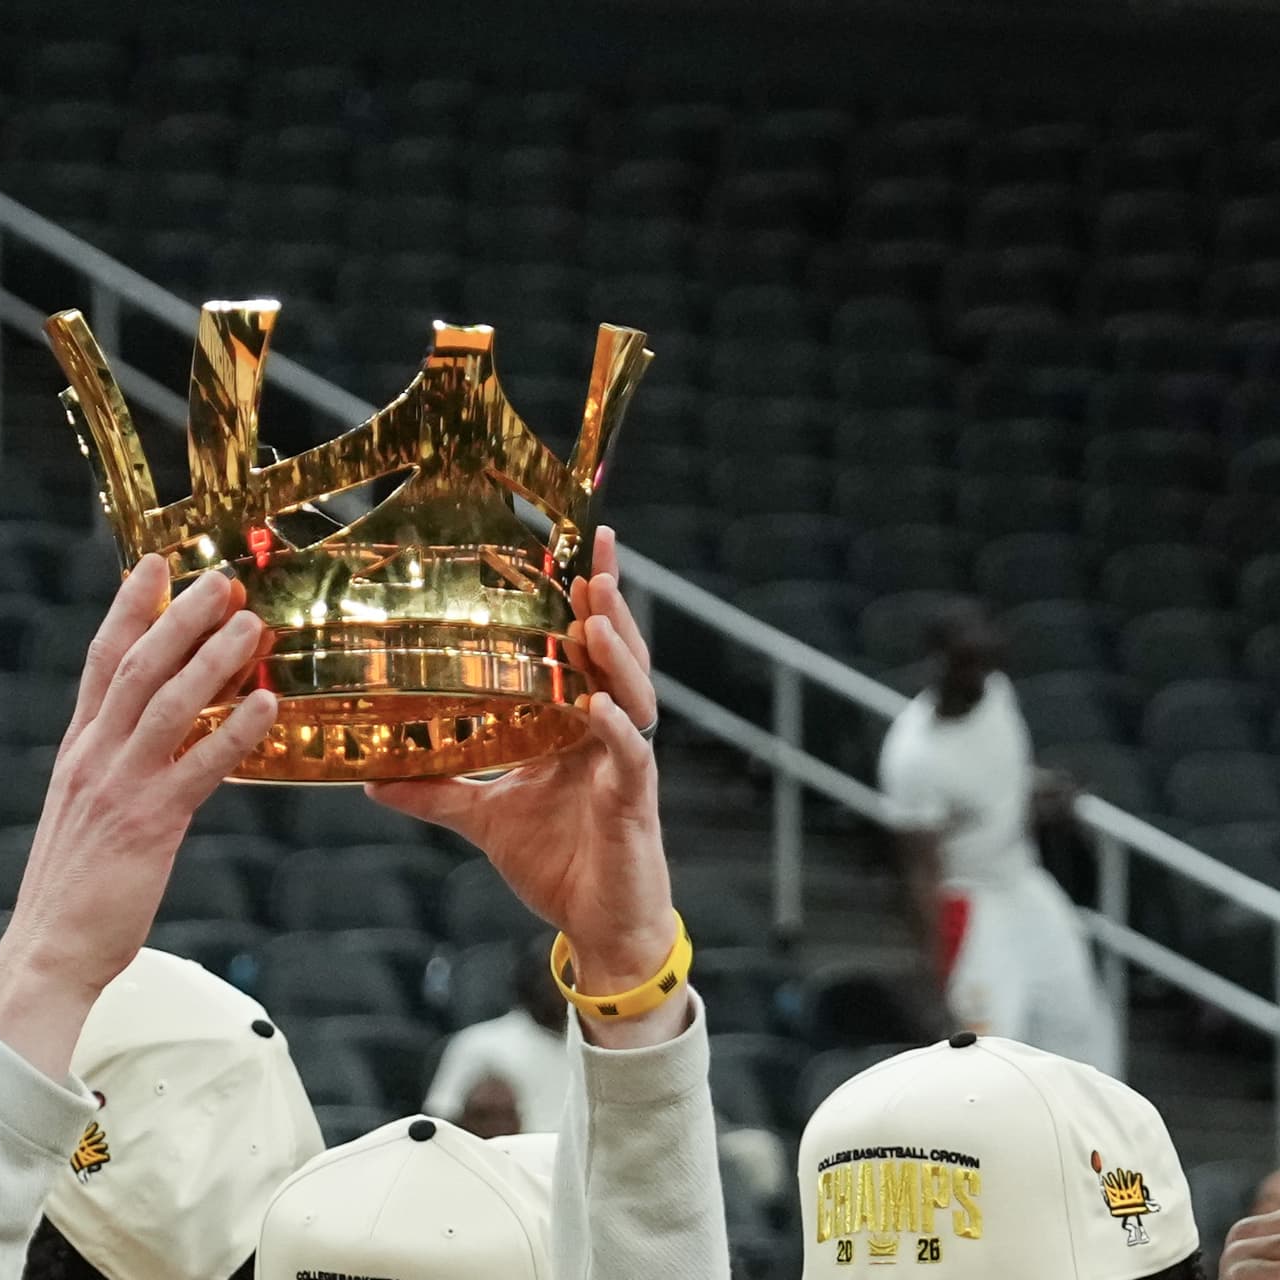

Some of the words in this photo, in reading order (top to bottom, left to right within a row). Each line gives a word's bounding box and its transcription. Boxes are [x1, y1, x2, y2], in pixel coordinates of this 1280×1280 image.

[853, 1146, 928, 1161] BASKETBALL
[930, 1149, 980, 1169] CROWN
[817, 1161, 983, 1243] CHAMPS
[837, 1239, 853, 1263] 20
[917, 1238, 941, 1262] 26
